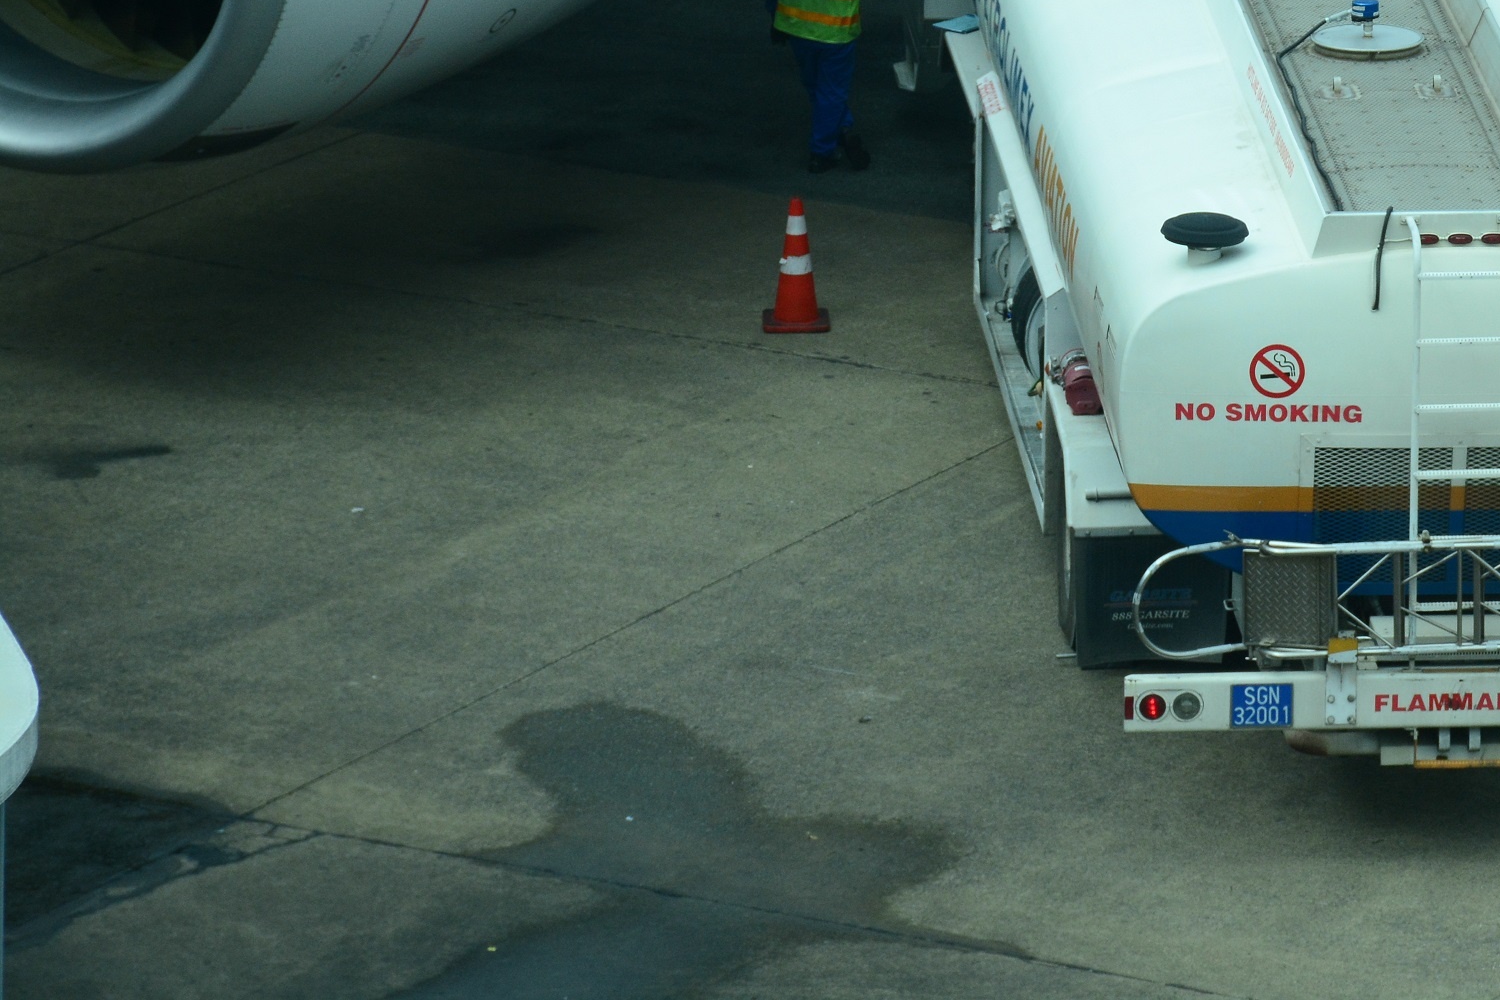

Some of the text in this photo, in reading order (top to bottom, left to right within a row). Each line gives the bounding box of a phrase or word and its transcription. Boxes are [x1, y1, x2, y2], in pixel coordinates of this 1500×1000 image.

[1034, 124, 1080, 283] AVIATION
[1175, 403, 1363, 423] NO SMOKING
[1244, 686, 1280, 705] SGN
[1234, 705, 1289, 725] 32001
